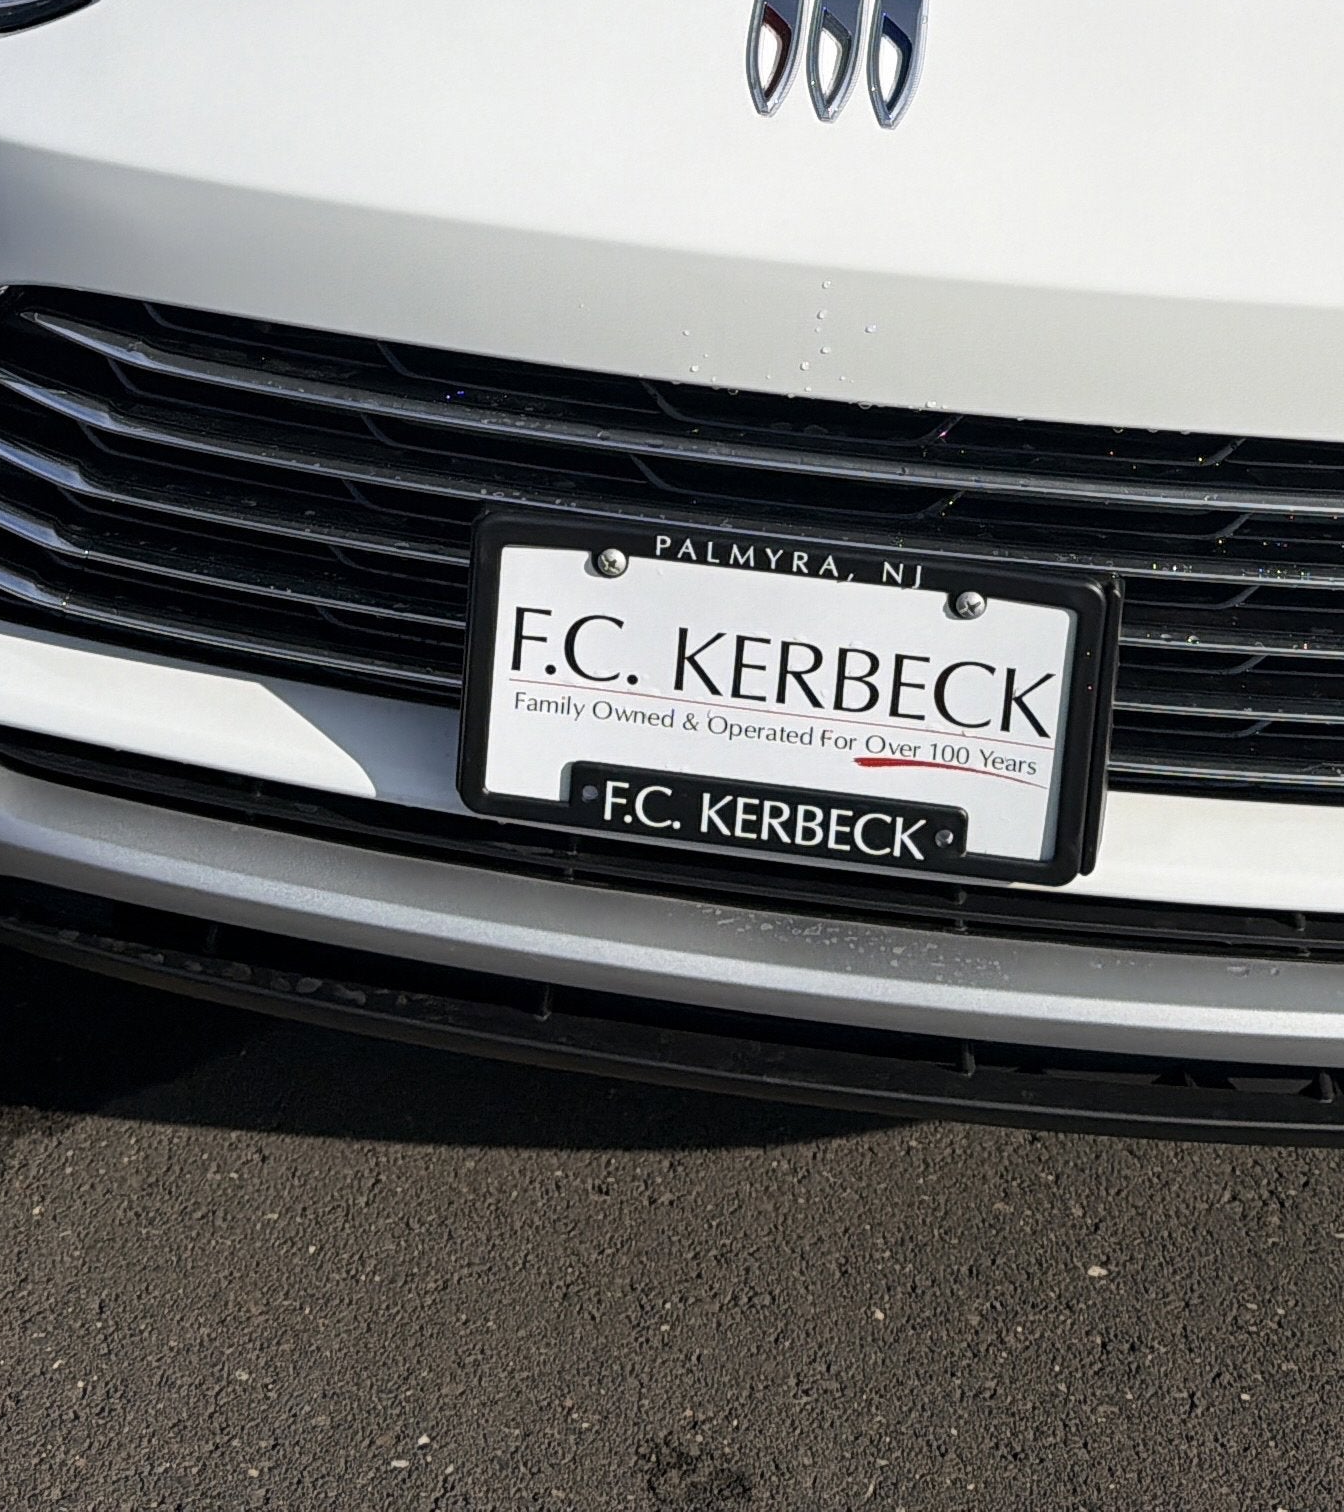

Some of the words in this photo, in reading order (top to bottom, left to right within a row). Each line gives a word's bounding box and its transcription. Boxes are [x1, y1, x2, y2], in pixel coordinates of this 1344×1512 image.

[655, 535, 855, 583] PALMYRA,
[881, 561, 923, 590] NJ
[509, 605, 638, 686] F.C.
[673, 626, 1057, 739] KERBECK
[514, 691, 586, 721] Family
[592, 700, 676, 729] Owned
[682, 712, 699, 732] &
[707, 714, 814, 746] Operated
[820, 729, 857, 751] For
[865, 734, 921, 759] Over
[930, 743, 970, 765] 100
[979, 748, 1038, 776] Years
[603, 780, 681, 830] F.C.
[700, 791, 928, 861] KERBECK
